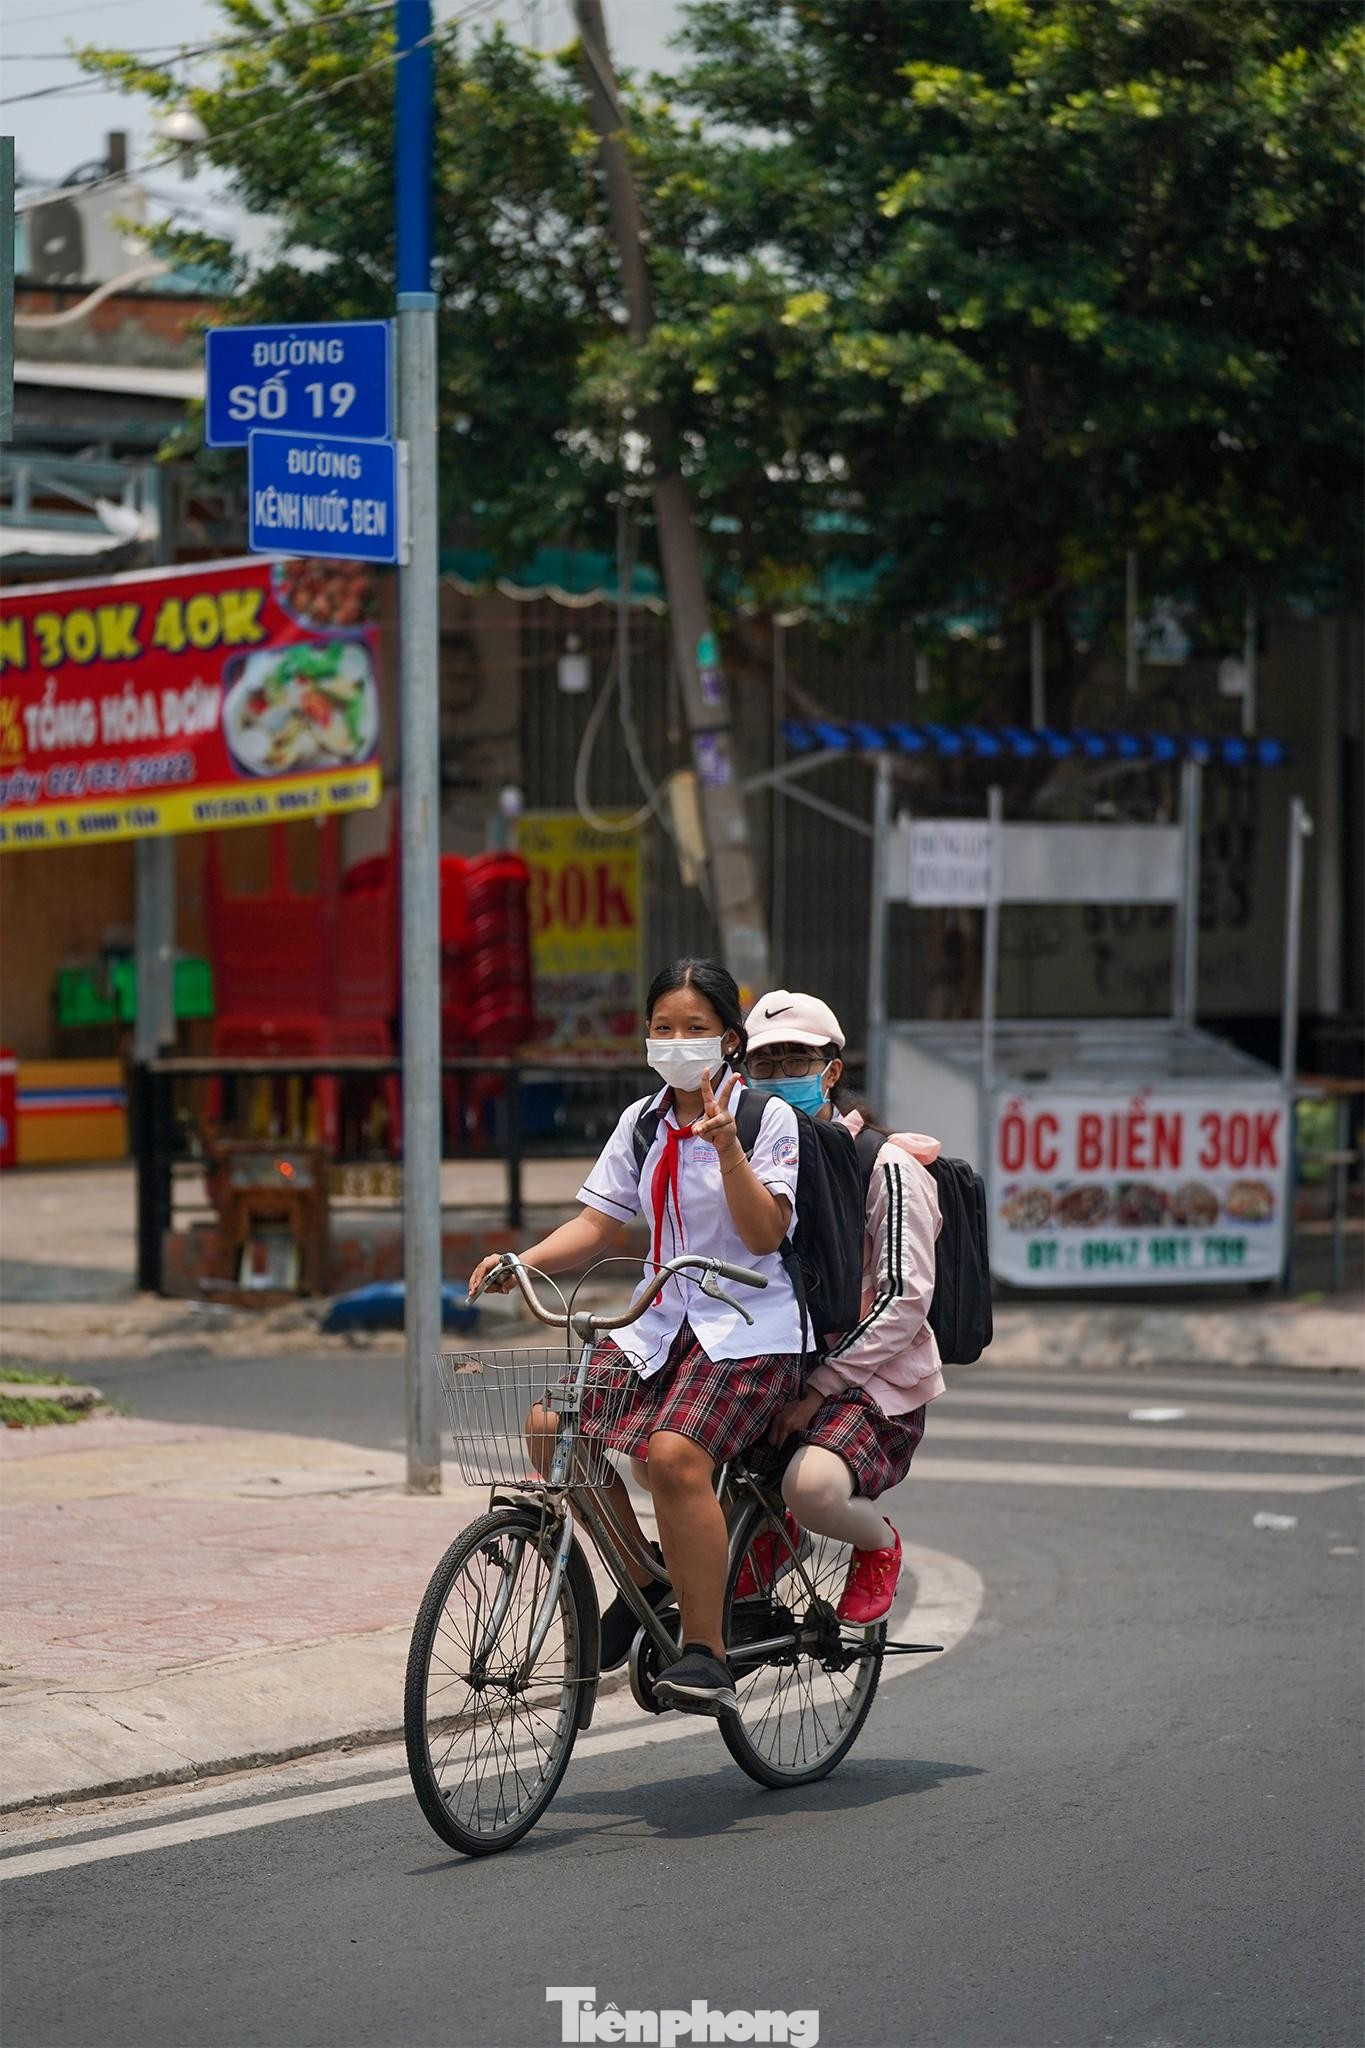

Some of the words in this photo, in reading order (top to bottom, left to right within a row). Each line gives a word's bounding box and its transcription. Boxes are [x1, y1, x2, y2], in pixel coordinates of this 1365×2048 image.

[252, 333, 344, 367] ĐƯỜNG
[228, 369, 291, 421] SỐ
[304, 382, 357, 419] 19
[287, 443, 361, 480] ĐƯỜNG
[255, 485, 299, 530] KÊNH
[302, 489, 348, 533] NƯỚC
[350, 499, 386, 537] ĐEN
[34, 602, 143, 668] 30K
[153, 589, 266, 652] 40K
[24, 676, 96, 752] TỔNG
[532, 863, 635, 932] 30K
[999, 1094, 1059, 1172] ỐC
[1076, 1085, 1182, 1172] BIỂN
[1199, 1110, 1281, 1169] 30K
